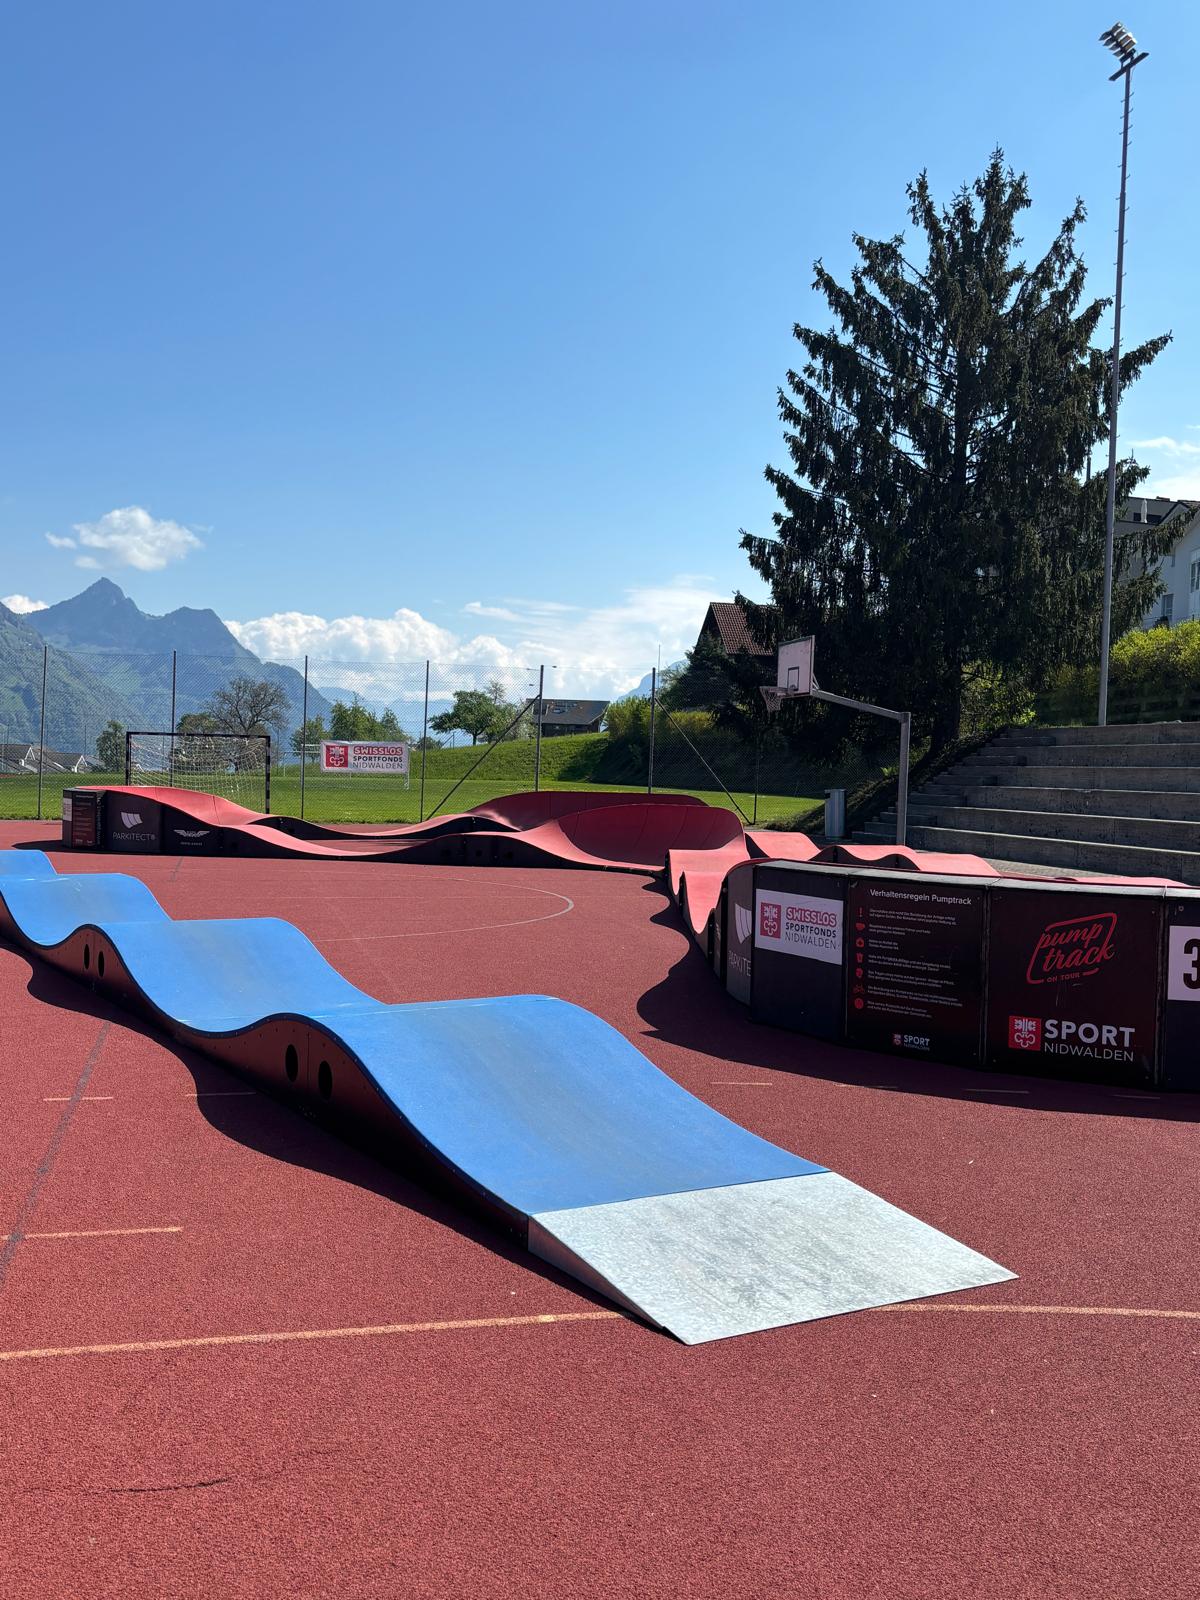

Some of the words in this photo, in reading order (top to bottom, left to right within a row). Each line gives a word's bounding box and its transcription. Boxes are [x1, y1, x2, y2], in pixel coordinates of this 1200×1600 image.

[353, 746, 403, 756] SWISSLOS
[352, 761, 403, 769] NIDWALDEN
[869, 888, 930, 901] Verhaltensregeln
[931, 894, 972, 905] Pumptrack
[786, 907, 837, 927] SWISSLOS
[785, 922, 837, 938] SPORTFONDS
[1039, 923, 1104, 949] pump
[785, 932, 837, 950] NIDWALDEN
[1042, 943, 1115, 972] track
[1046, 975, 1058, 983] ON
[1060, 972, 1081, 981] TOUR
[903, 1034, 930, 1046] SPORT
[1044, 1019, 1136, 1048] SPORT
[1044, 1042, 1134, 1062] NIDWALDEN
